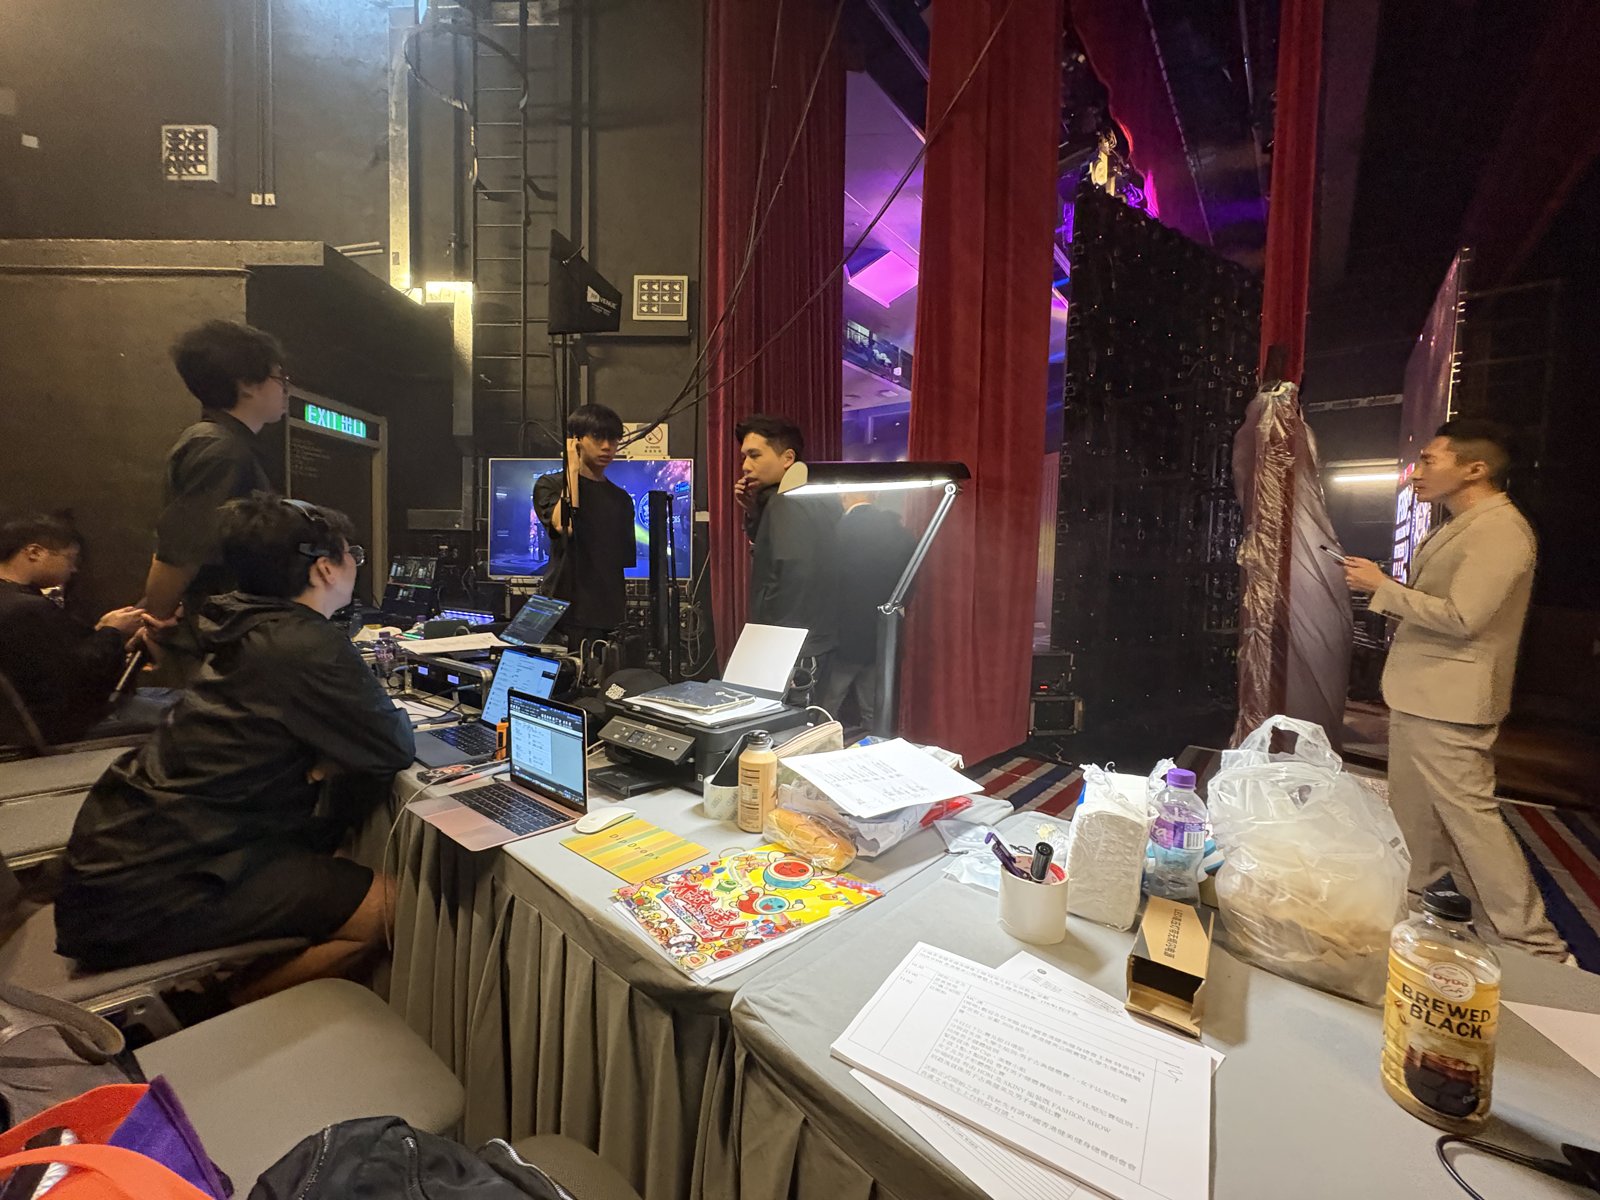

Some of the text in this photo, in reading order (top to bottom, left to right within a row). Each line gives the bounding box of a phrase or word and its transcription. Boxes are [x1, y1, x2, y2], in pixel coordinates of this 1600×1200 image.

[308, 404, 364, 438] EXIT 出口
[1402, 983, 1491, 1022] BREWED
[1410, 1004, 1482, 1039] BLACK
[1002, 1079, 1026, 1094] SKINY
[1050, 1101, 1088, 1124] FASHION
[1086, 1117, 1111, 1134] SHOW
